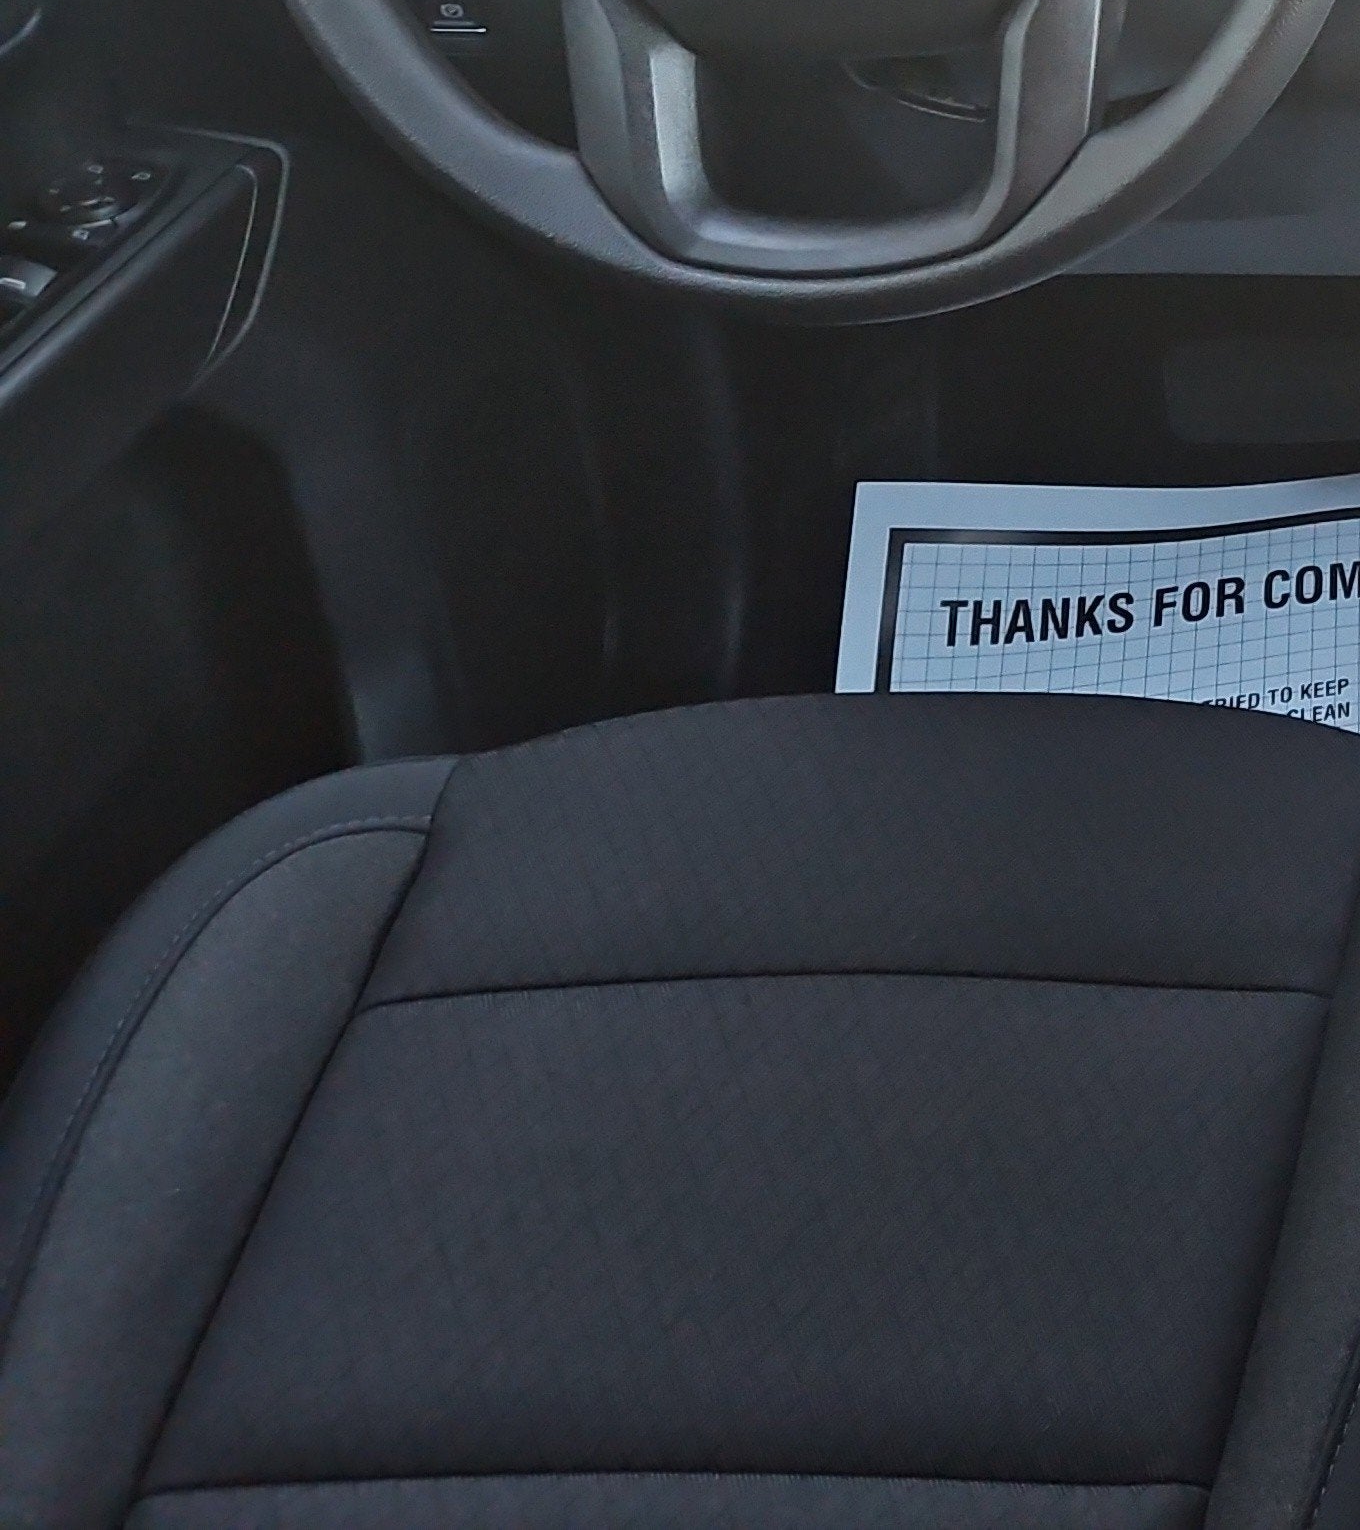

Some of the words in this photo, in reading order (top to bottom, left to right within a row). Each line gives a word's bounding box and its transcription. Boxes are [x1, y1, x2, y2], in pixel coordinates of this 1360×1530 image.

[940, 591, 1135, 647] THANKS
[1153, 577, 1245, 627] FOR
[1267, 686, 1293, 705] TO
[1300, 678, 1349, 700] KEEP
